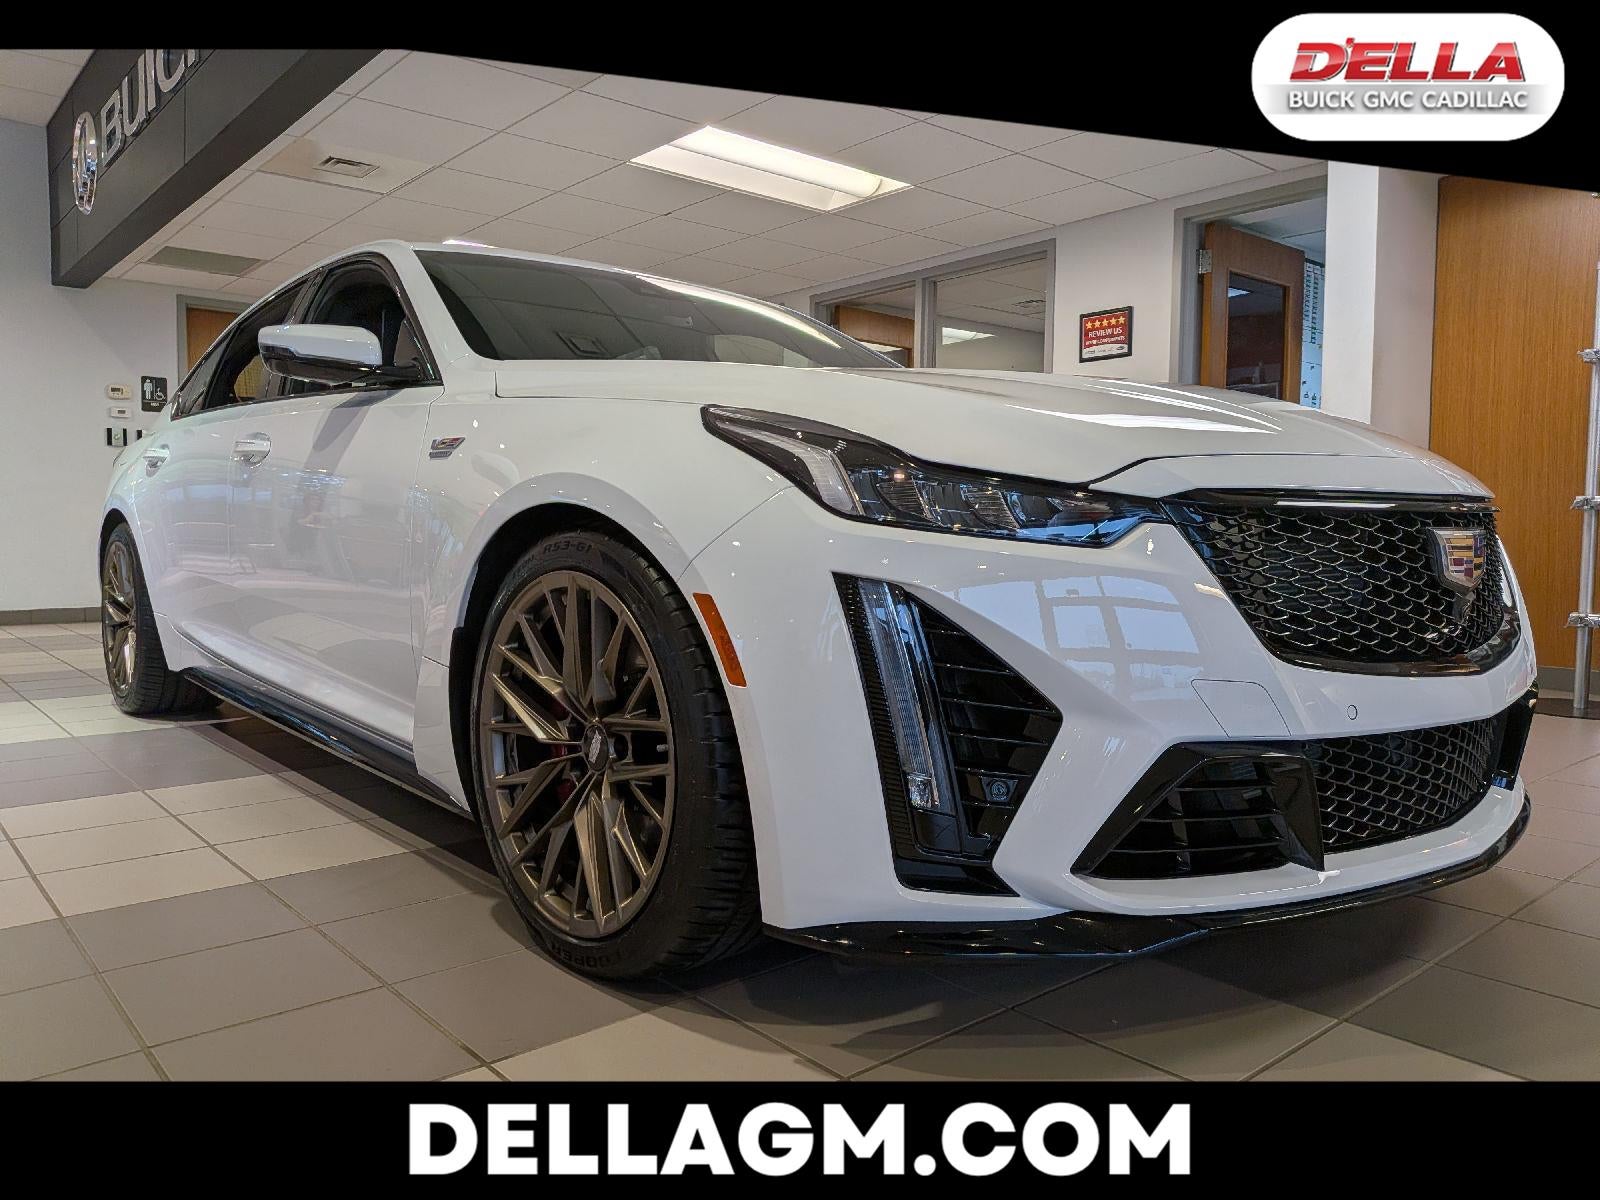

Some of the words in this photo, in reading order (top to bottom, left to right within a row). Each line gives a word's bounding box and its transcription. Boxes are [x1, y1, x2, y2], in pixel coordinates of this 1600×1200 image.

[101, 49, 196, 167] BUIC
[1089, 328, 1112, 338] REVIEW
[1113, 327, 1122, 335] US
